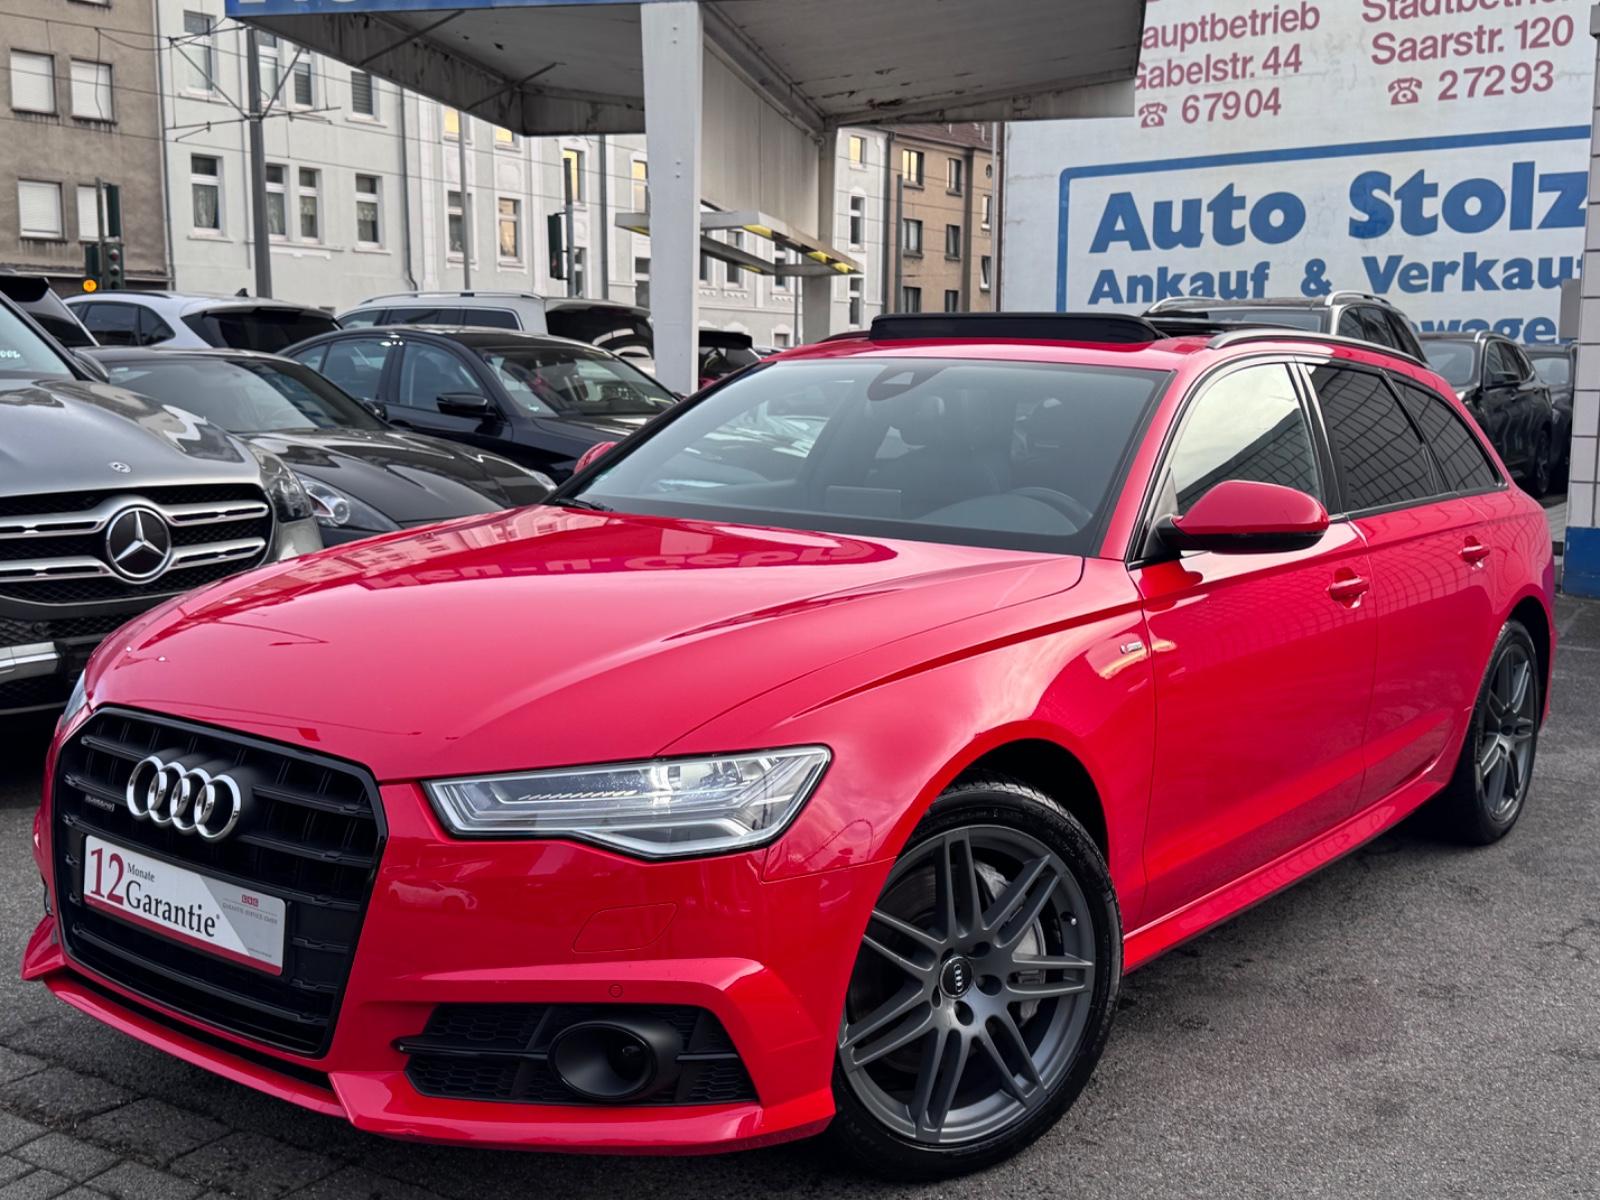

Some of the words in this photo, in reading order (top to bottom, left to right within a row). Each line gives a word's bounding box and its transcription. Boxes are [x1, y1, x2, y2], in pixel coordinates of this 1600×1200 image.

[1142, 2, 1320, 52] auptbetrieb
[1371, 24, 1504, 65] Saarstr.
[1514, 14, 1574, 50] 120
[1262, 43, 1302, 76] 44
[1438, 60, 1554, 101] 27293
[1181, 87, 1281, 124] 67904
[1088, 182, 1306, 253] Auto
[1348, 161, 1588, 239] Stolz
[1087, 261, 1270, 305] Ankauf
[1300, 258, 1332, 297] &
[1362, 252, 1584, 294] Verkau
[91, 848, 124, 905] 12
[128, 862, 155, 882] Monate
